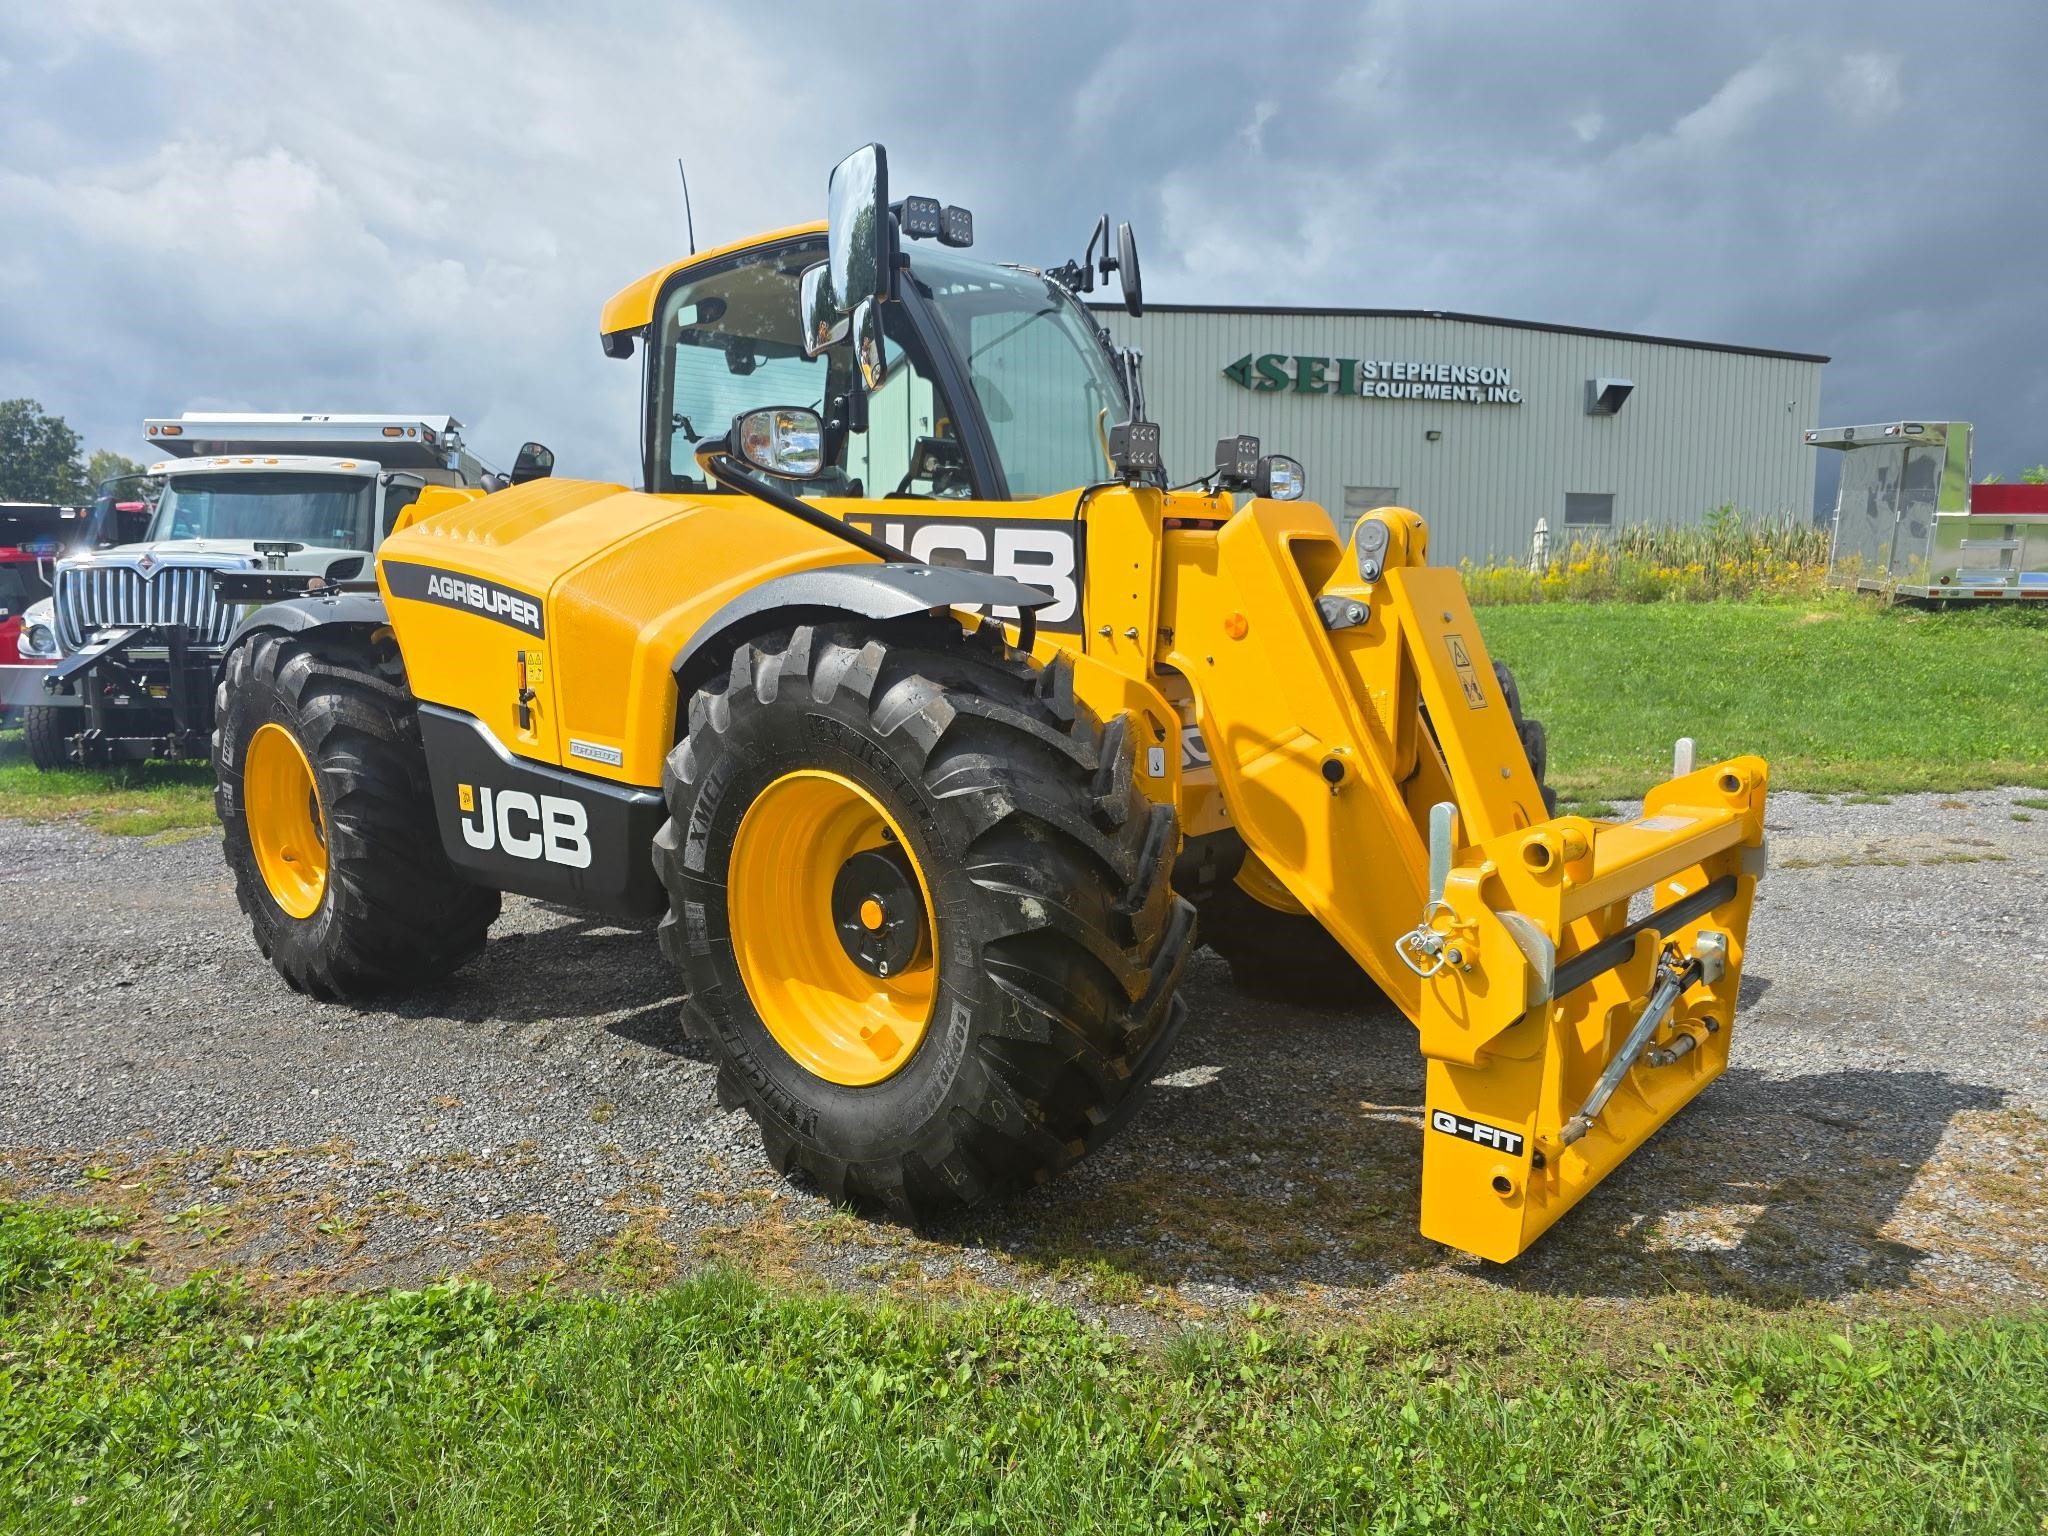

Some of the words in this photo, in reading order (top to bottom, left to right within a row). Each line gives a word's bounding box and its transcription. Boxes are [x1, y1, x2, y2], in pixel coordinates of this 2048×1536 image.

[1255, 353, 1360, 395] SEI
[1362, 360, 1511, 386] STEPHENSON
[1362, 381, 1481, 404] EQUIPMENT,
[1488, 386, 1526, 403] INC.
[885, 523, 1077, 623] CB
[428, 574, 540, 630] AGRISUPER
[459, 785, 592, 869] JCB
[1433, 1111, 1522, 1153] Q-FIT
